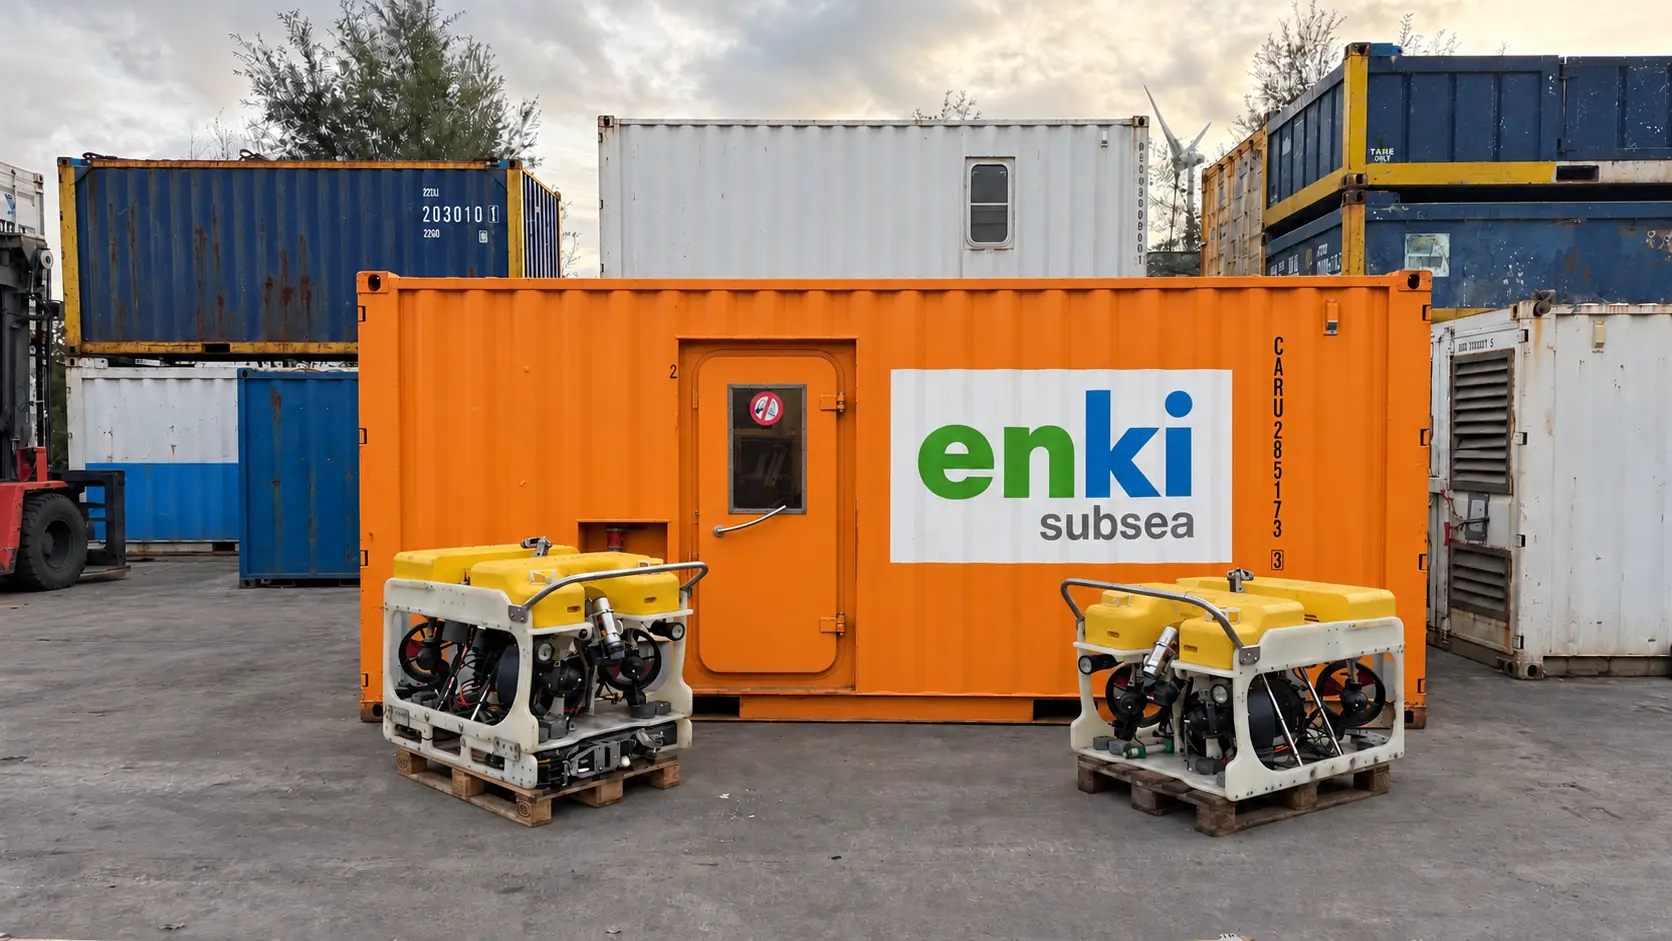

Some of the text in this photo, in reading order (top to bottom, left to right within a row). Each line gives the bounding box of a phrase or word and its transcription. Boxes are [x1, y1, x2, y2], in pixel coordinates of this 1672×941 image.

[422, 205, 483, 222] 203010
[669, 364, 678, 379] 2
[918, 389, 1193, 500] enki
[1040, 505, 1194, 540] subsea
[1273, 552, 1282, 569] 3
